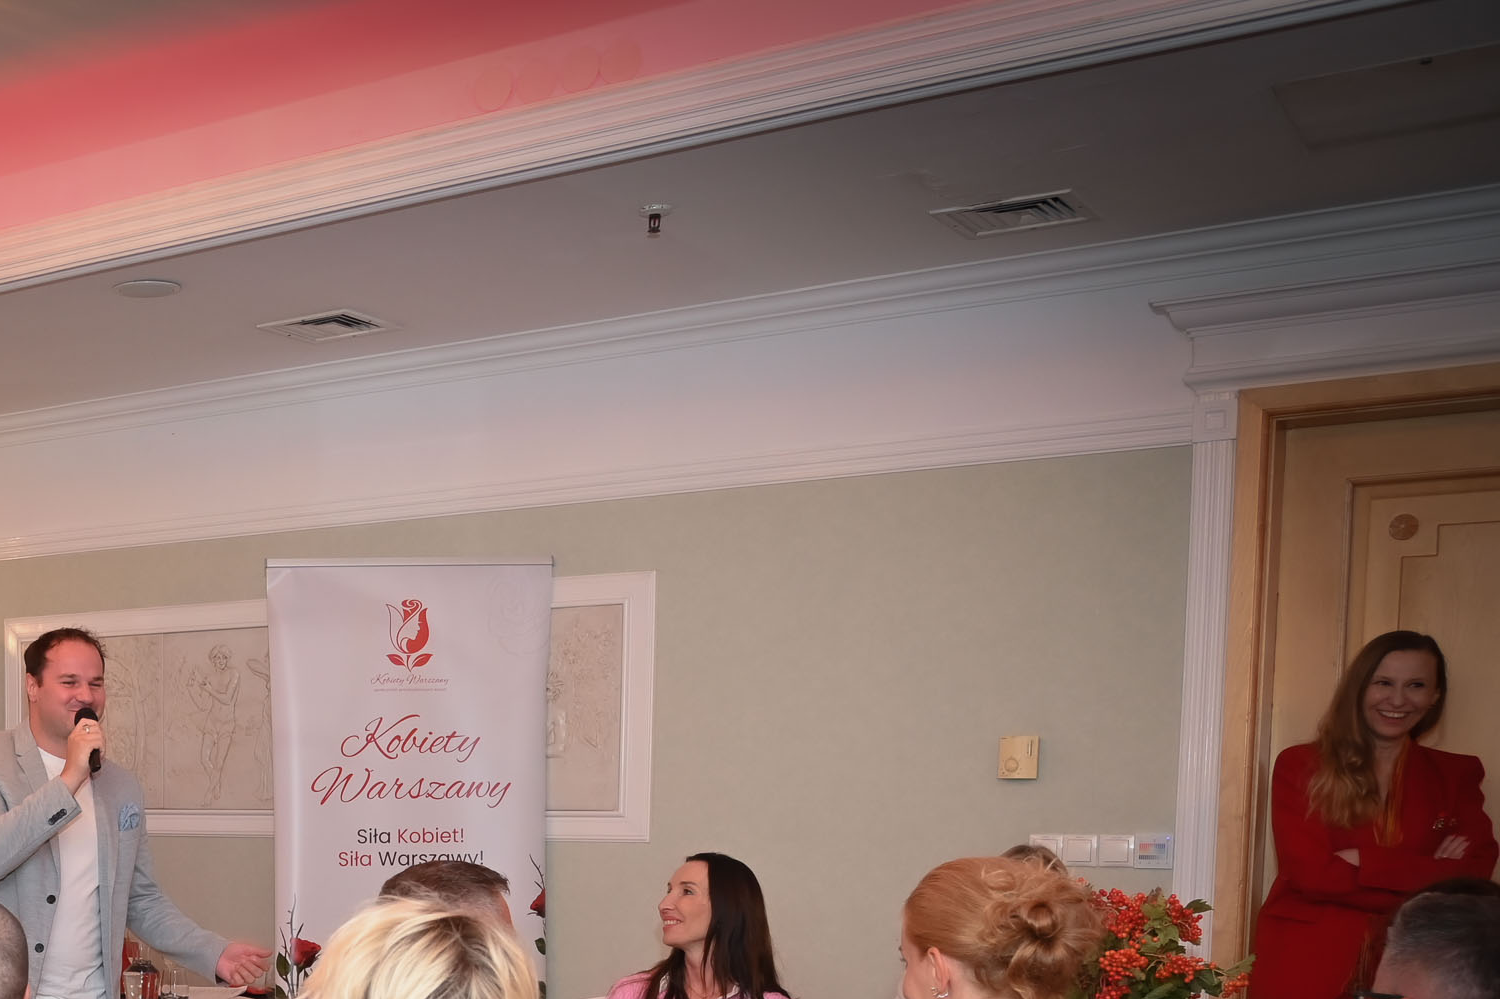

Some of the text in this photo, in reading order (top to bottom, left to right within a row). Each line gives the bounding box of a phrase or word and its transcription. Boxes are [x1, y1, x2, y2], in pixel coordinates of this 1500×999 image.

[340, 714, 482, 763] Kobiety
[310, 766, 513, 809] Warszawy
[357, 828, 465, 845] Siła Kobiet!
[338, 851, 373, 867] Siła
